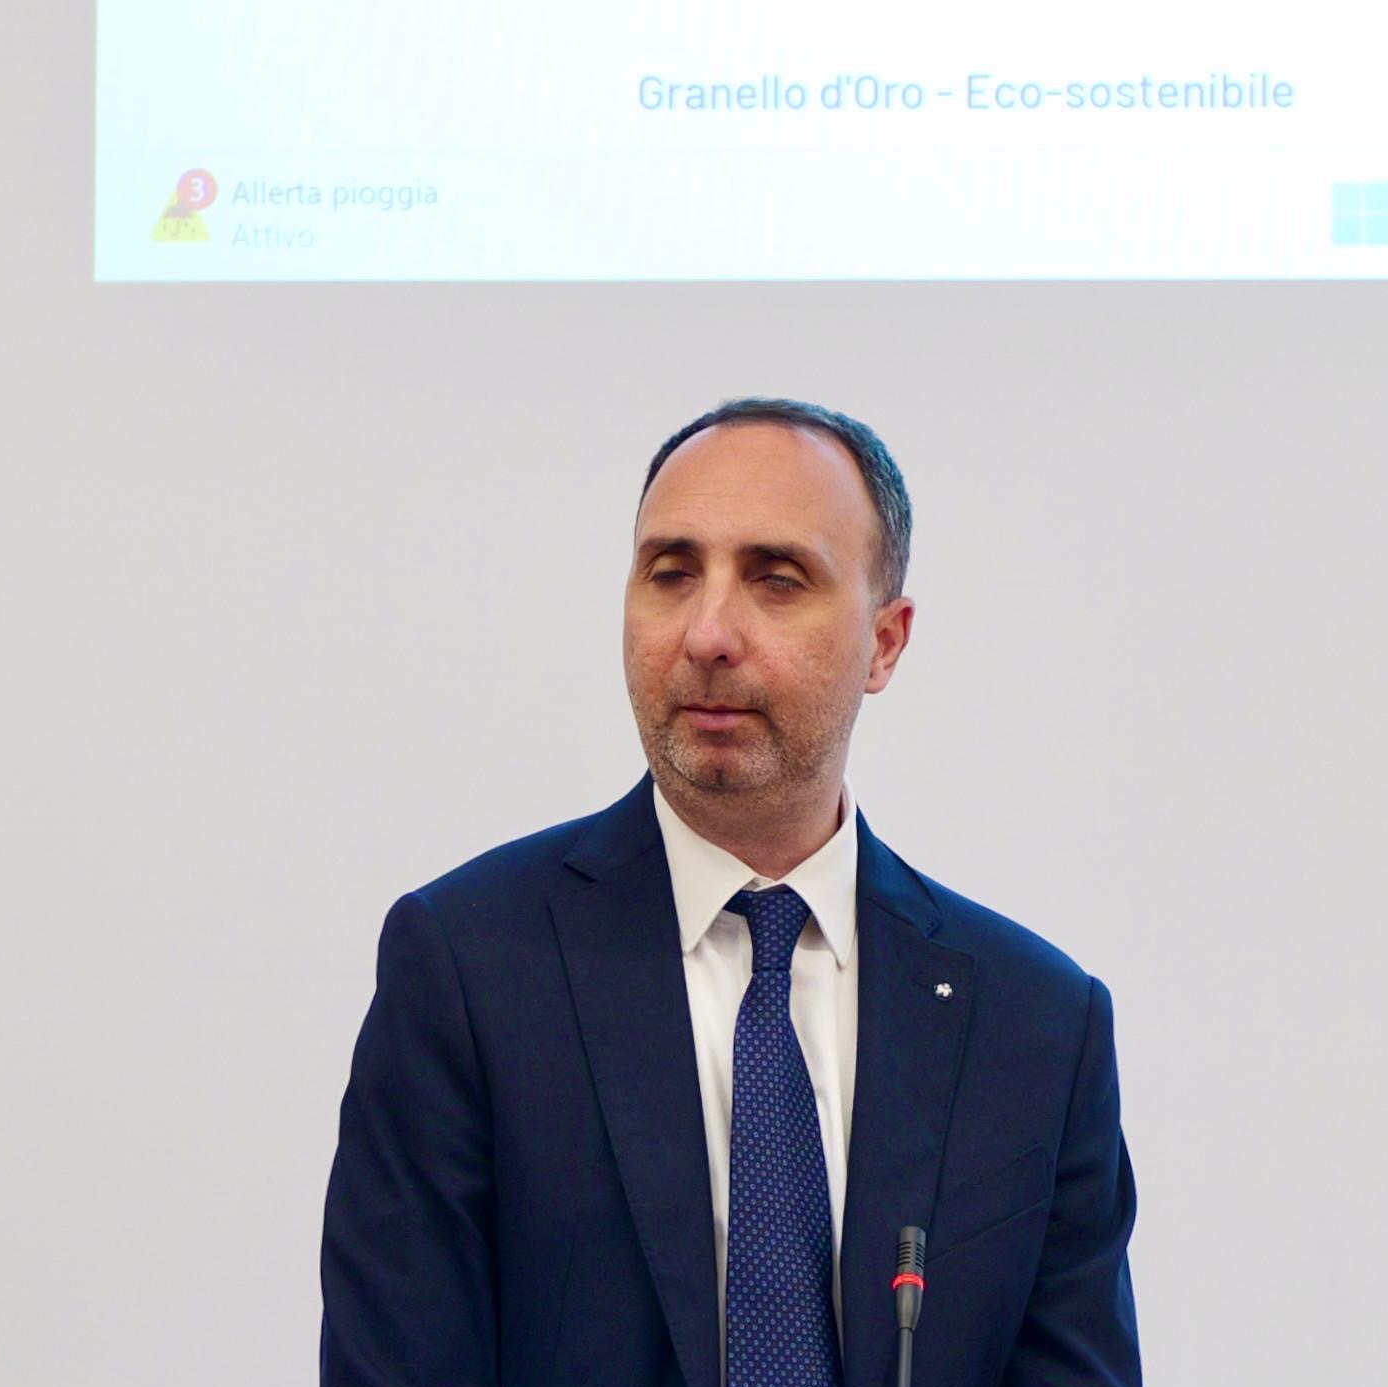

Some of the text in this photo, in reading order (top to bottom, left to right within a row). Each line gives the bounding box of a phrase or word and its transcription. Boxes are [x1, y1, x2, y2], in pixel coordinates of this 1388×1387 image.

[638, 74, 807, 110] Granello
[819, 74, 923, 110] d'Oro
[966, 72, 1295, 110] Eco-sostenibile
[189, 177, 206, 201] 3
[231, 177, 439, 210] Allerta pioggia
[231, 223, 316, 249] Attivo
